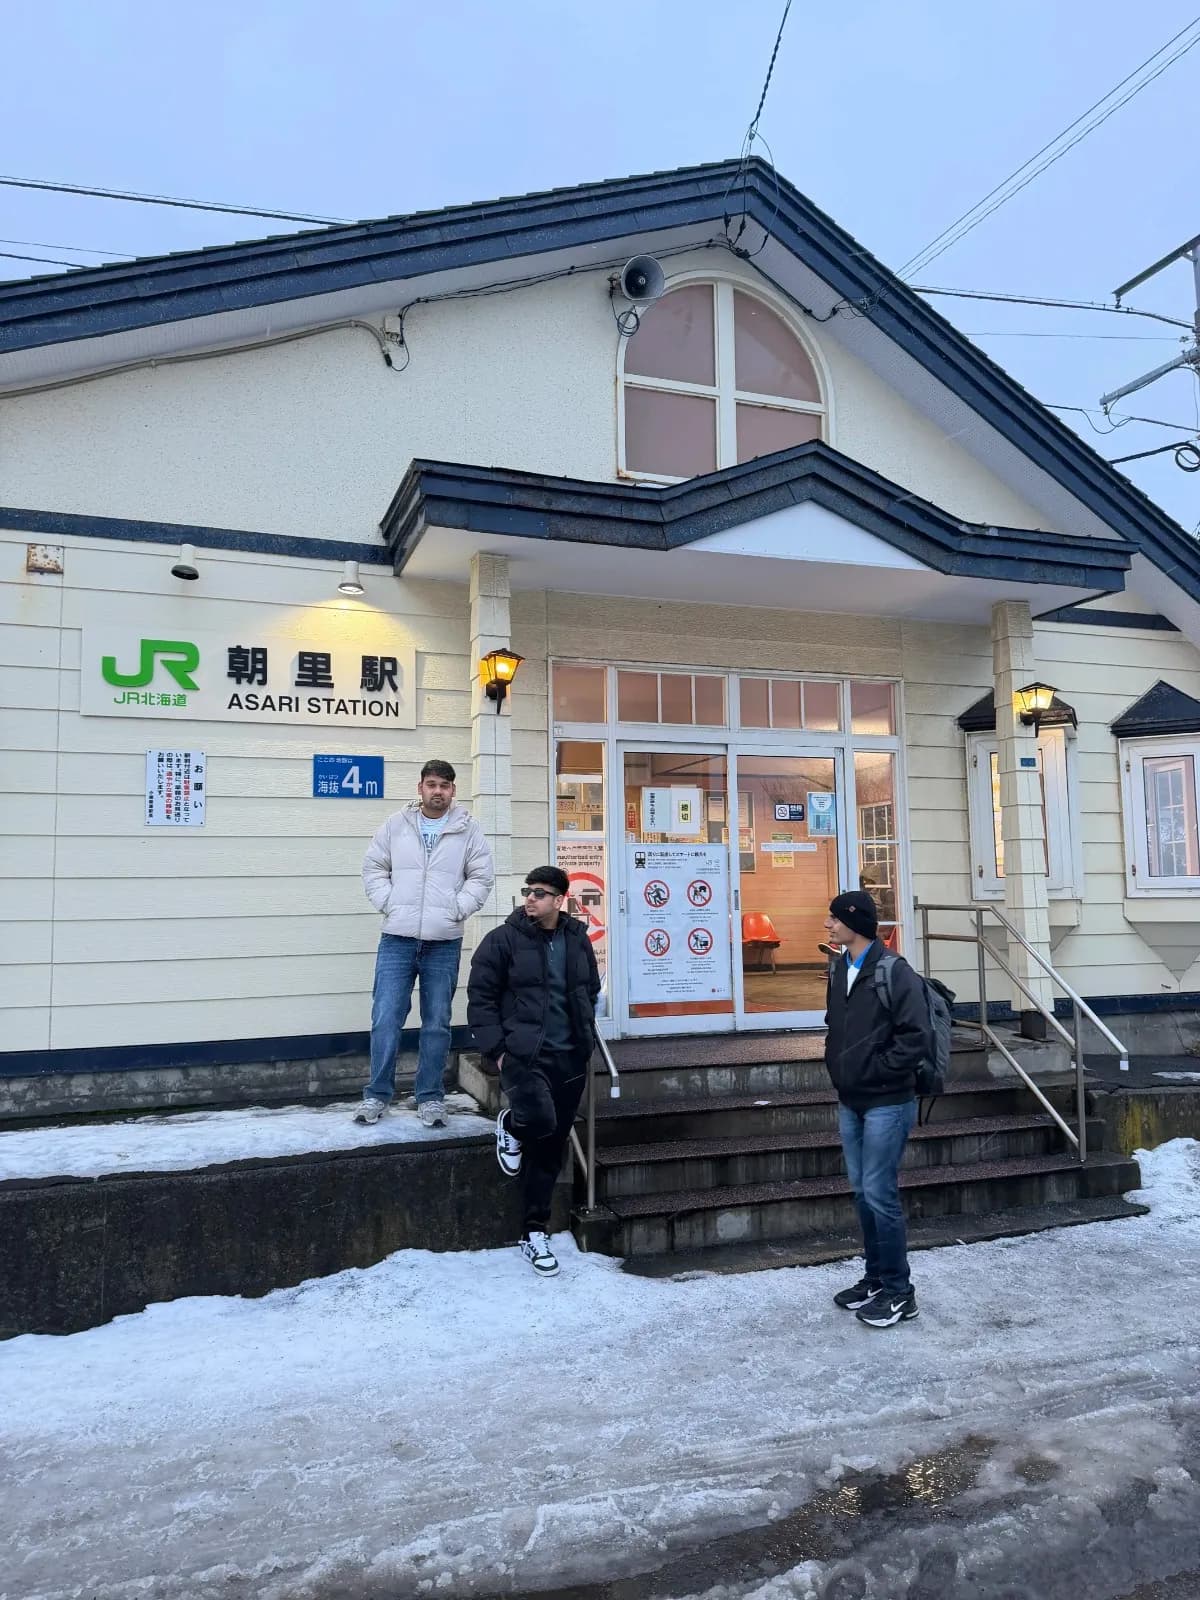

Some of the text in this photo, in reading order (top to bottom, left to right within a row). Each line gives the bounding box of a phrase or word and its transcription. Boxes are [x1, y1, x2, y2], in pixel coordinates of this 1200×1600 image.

[102, 639, 200, 690] JR
[226, 645, 399, 692] 朝里駅
[113, 692, 188, 707] JR北海道
[227, 693, 400, 717] ASARI STATION
[193, 765, 204, 809] お願い
[317, 780, 340, 794] 海抜
